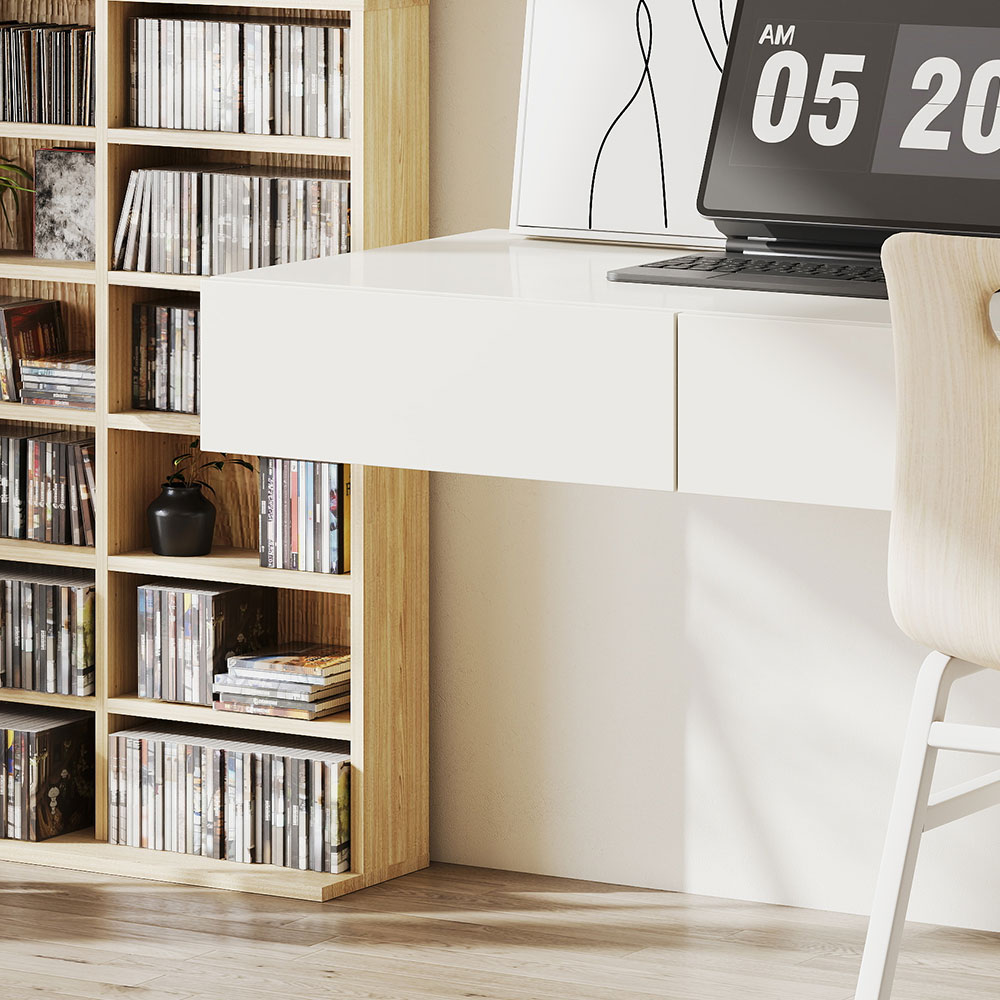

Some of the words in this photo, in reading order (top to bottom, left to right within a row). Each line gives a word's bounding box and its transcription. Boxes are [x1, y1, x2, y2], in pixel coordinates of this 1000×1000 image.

[758, 23, 796, 46] AM
[751, 50, 867, 147] 05
[899, 56, 1000, 155] 20
